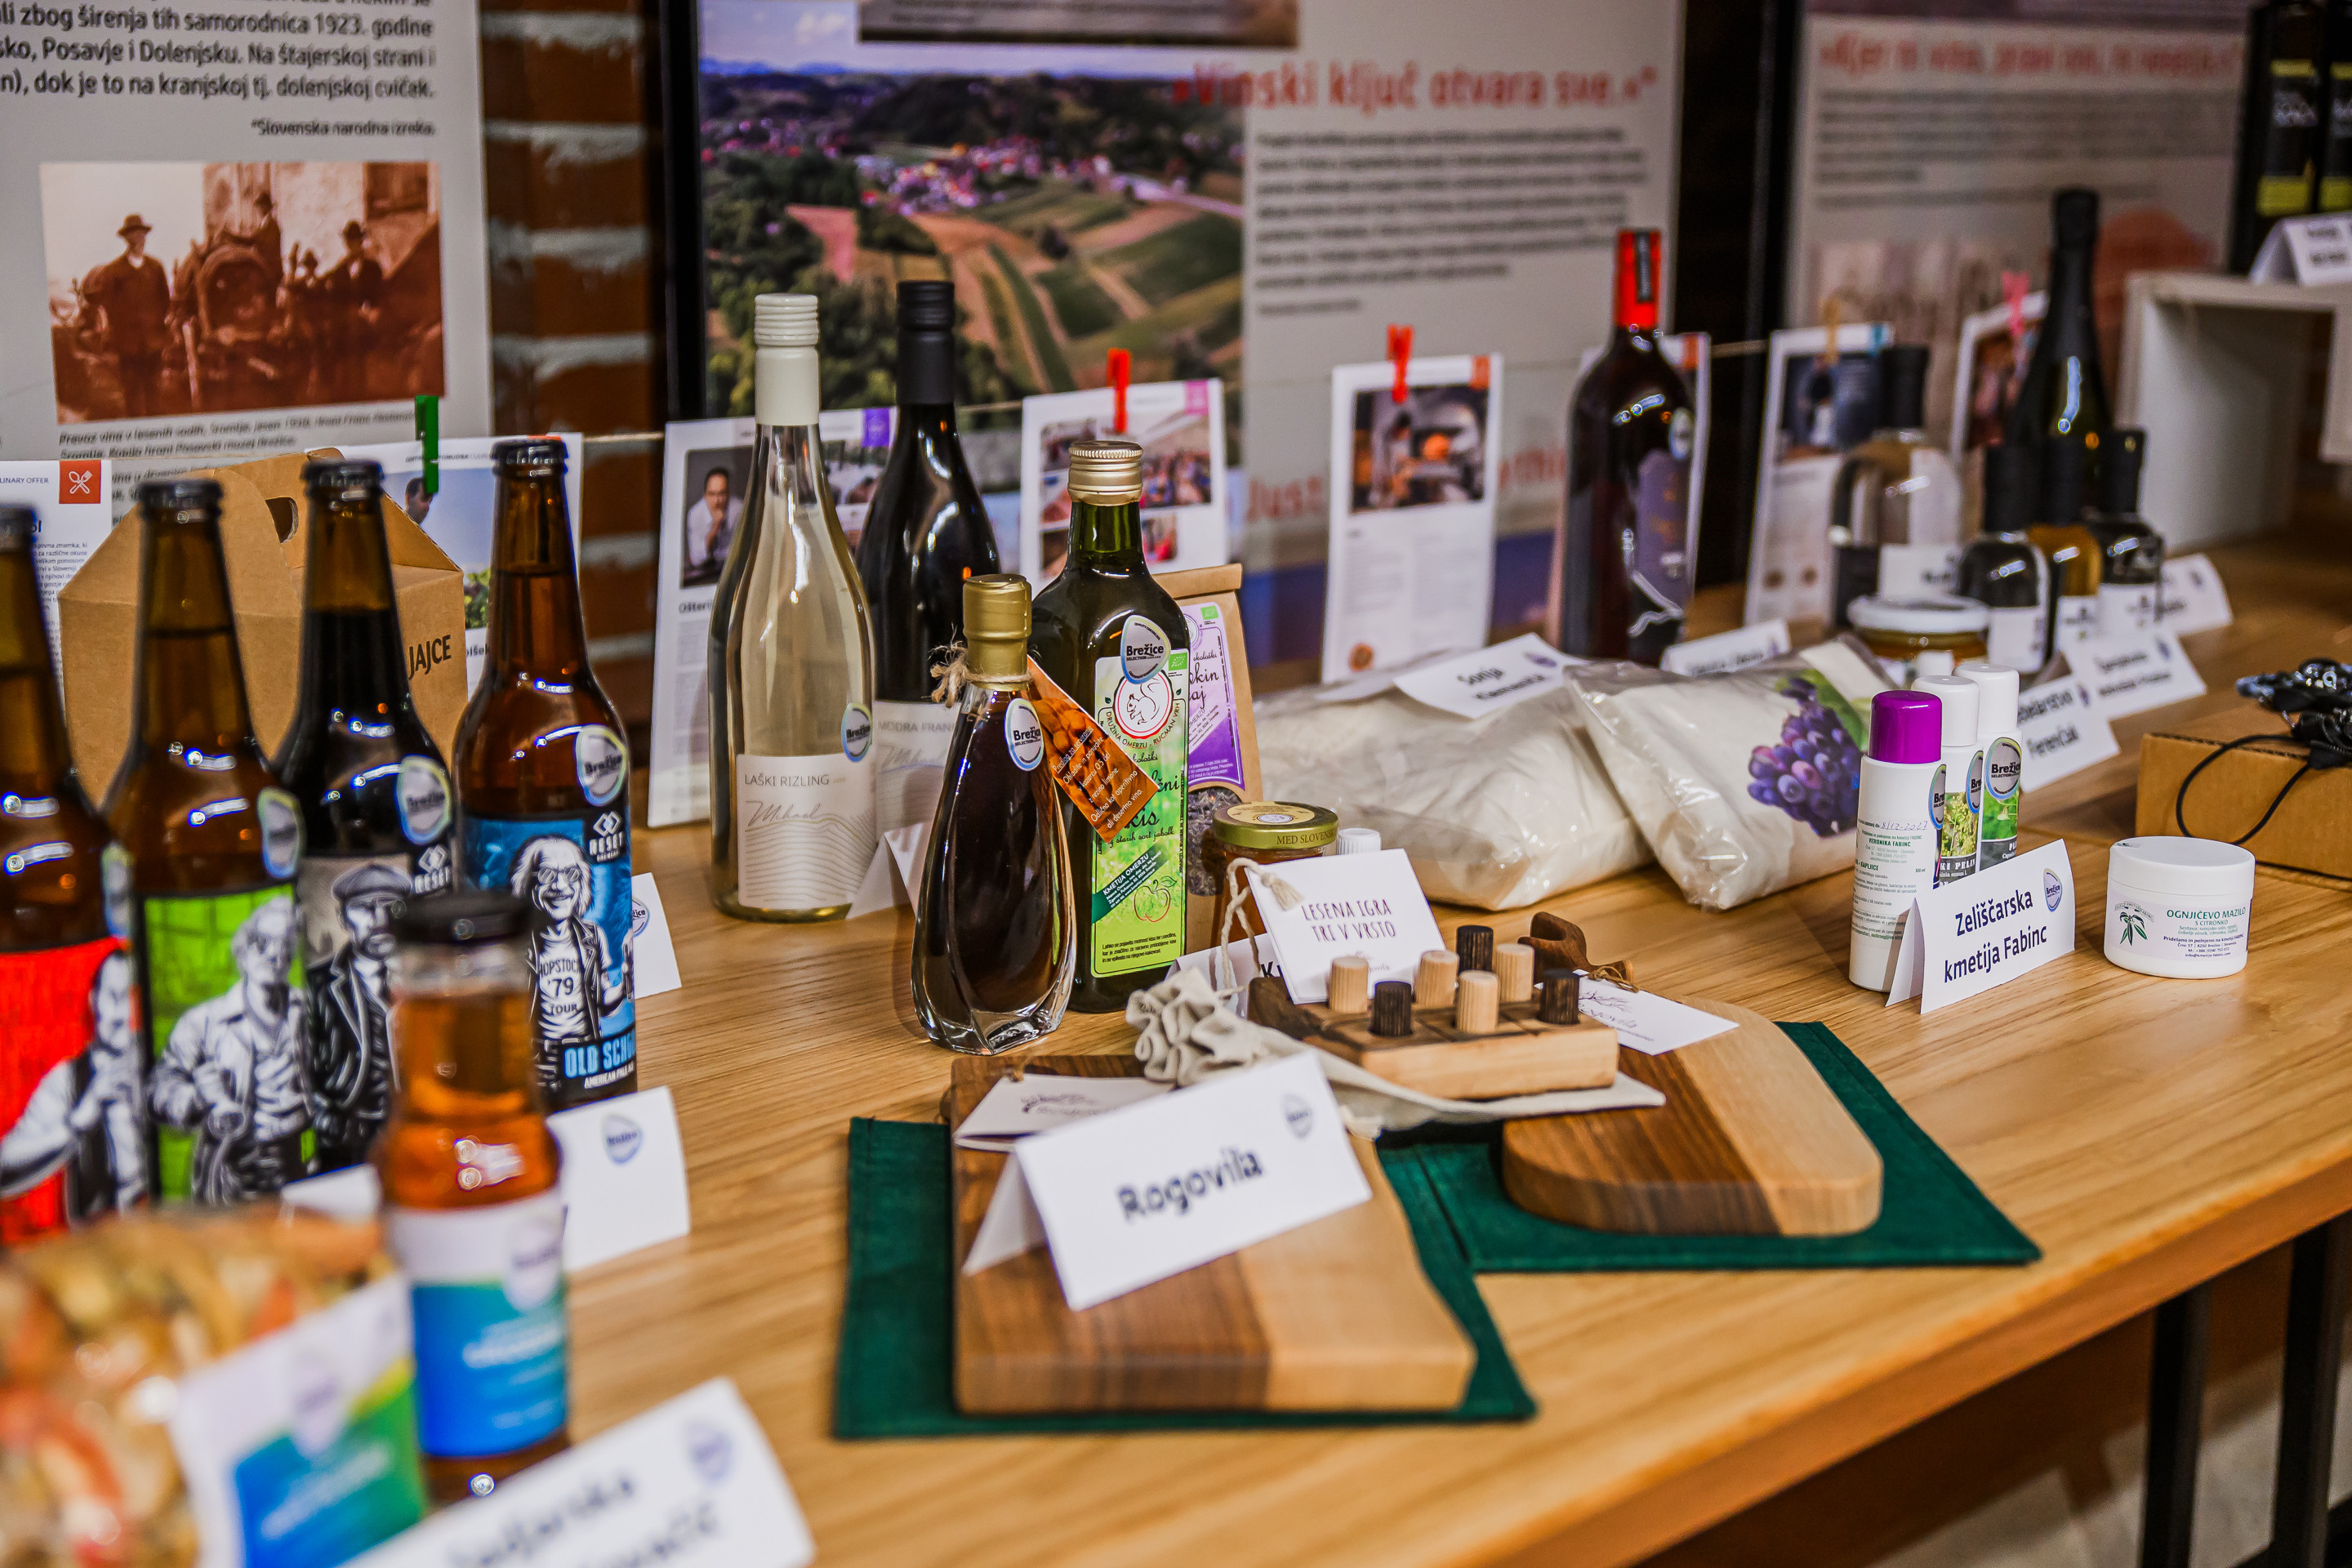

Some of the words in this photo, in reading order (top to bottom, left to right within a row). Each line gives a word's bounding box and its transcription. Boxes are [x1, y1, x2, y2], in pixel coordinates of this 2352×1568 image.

[20, 2, 74, 32] zbog
[78, 5, 148, 33] širenja
[153, 7, 180, 30] tih
[184, 11, 310, 34] samorodnica
[314, 12, 367, 36] 1923.
[372, 16, 434, 40] godine
[42, 36, 123, 65] Posavje
[129, 39, 135, 61] i
[139, 39, 243, 68] Dolenjsku.
[247, 43, 274, 65] Na
[278, 42, 369, 69] Štajerskoj
[373, 46, 424, 67] strani
[33, 69, 74, 95] dok
[78, 70, 97, 98] je
[103, 73, 123, 95] to
[129, 77, 154, 95] na
[158, 72, 248, 100] kranjskoj
[276, 73, 372, 100] dolenjskoj
[408, 634, 452, 680] JAJCE
[1126, 643, 1165, 657] Brežice
[1193, 649, 1218, 662] ekološki
[878, 720, 918, 733] MODRA
[1106, 710, 1121, 742] DRUŽINA
[1121, 738, 1147, 750] OMERZU
[1152, 719, 1176, 745] RUCMAN
[1052, 754, 1070, 772] Predlog
[1062, 762, 1083, 784] Ohladite
[1081, 756, 1087, 765] in
[1085, 737, 1104, 760] ponudite
[1132, 751, 1158, 764] kološki
[744, 772, 777, 786] LAŠKI
[780, 773, 829, 786] RIZLING
[1090, 803, 1110, 823] Odlično
[1108, 795, 1116, 805] kot
[1115, 770, 1138, 797] aperitivno
[1091, 784, 1105, 800] rezino
[1112, 800, 1134, 822] desertno
[1131, 789, 1143, 802] vino.
[588, 831, 626, 856] RESET
[1116, 831, 1136, 844] starih
[1138, 831, 1151, 840] sort
[1152, 825, 1174, 842] jabolk
[1276, 835, 1298, 845] MED
[1869, 838, 1891, 847] VERONIKA
[1102, 875, 1126, 896] KMETIJA
[1125, 853, 1149, 876] OMERZU
[1860, 861, 1879, 871] KAPLJICE
[1954, 858, 1976, 871] PELIN
[1301, 900, 1355, 922] LESENA
[1357, 898, 1392, 917] IGRA
[1955, 889, 2034, 937] Zeliščarska
[2167, 909, 2221, 920] OGNJIČEVO
[2221, 906, 2247, 919] MAZILO
[1311, 924, 1337, 942] TRI
[1338, 924, 1348, 940] V
[1352, 920, 1397, 940] VRSTO
[1944, 941, 2001, 983] kmetija
[2003, 924, 2047, 960] Fabinc
[549, 1003, 578, 1016] TOUR
[564, 1045, 599, 1080] OLD
[584, 1068, 617, 1089] AMERICAN
[616, 1062, 629, 1079] PALE
[1116, 1147, 1263, 1223] Rogovila
